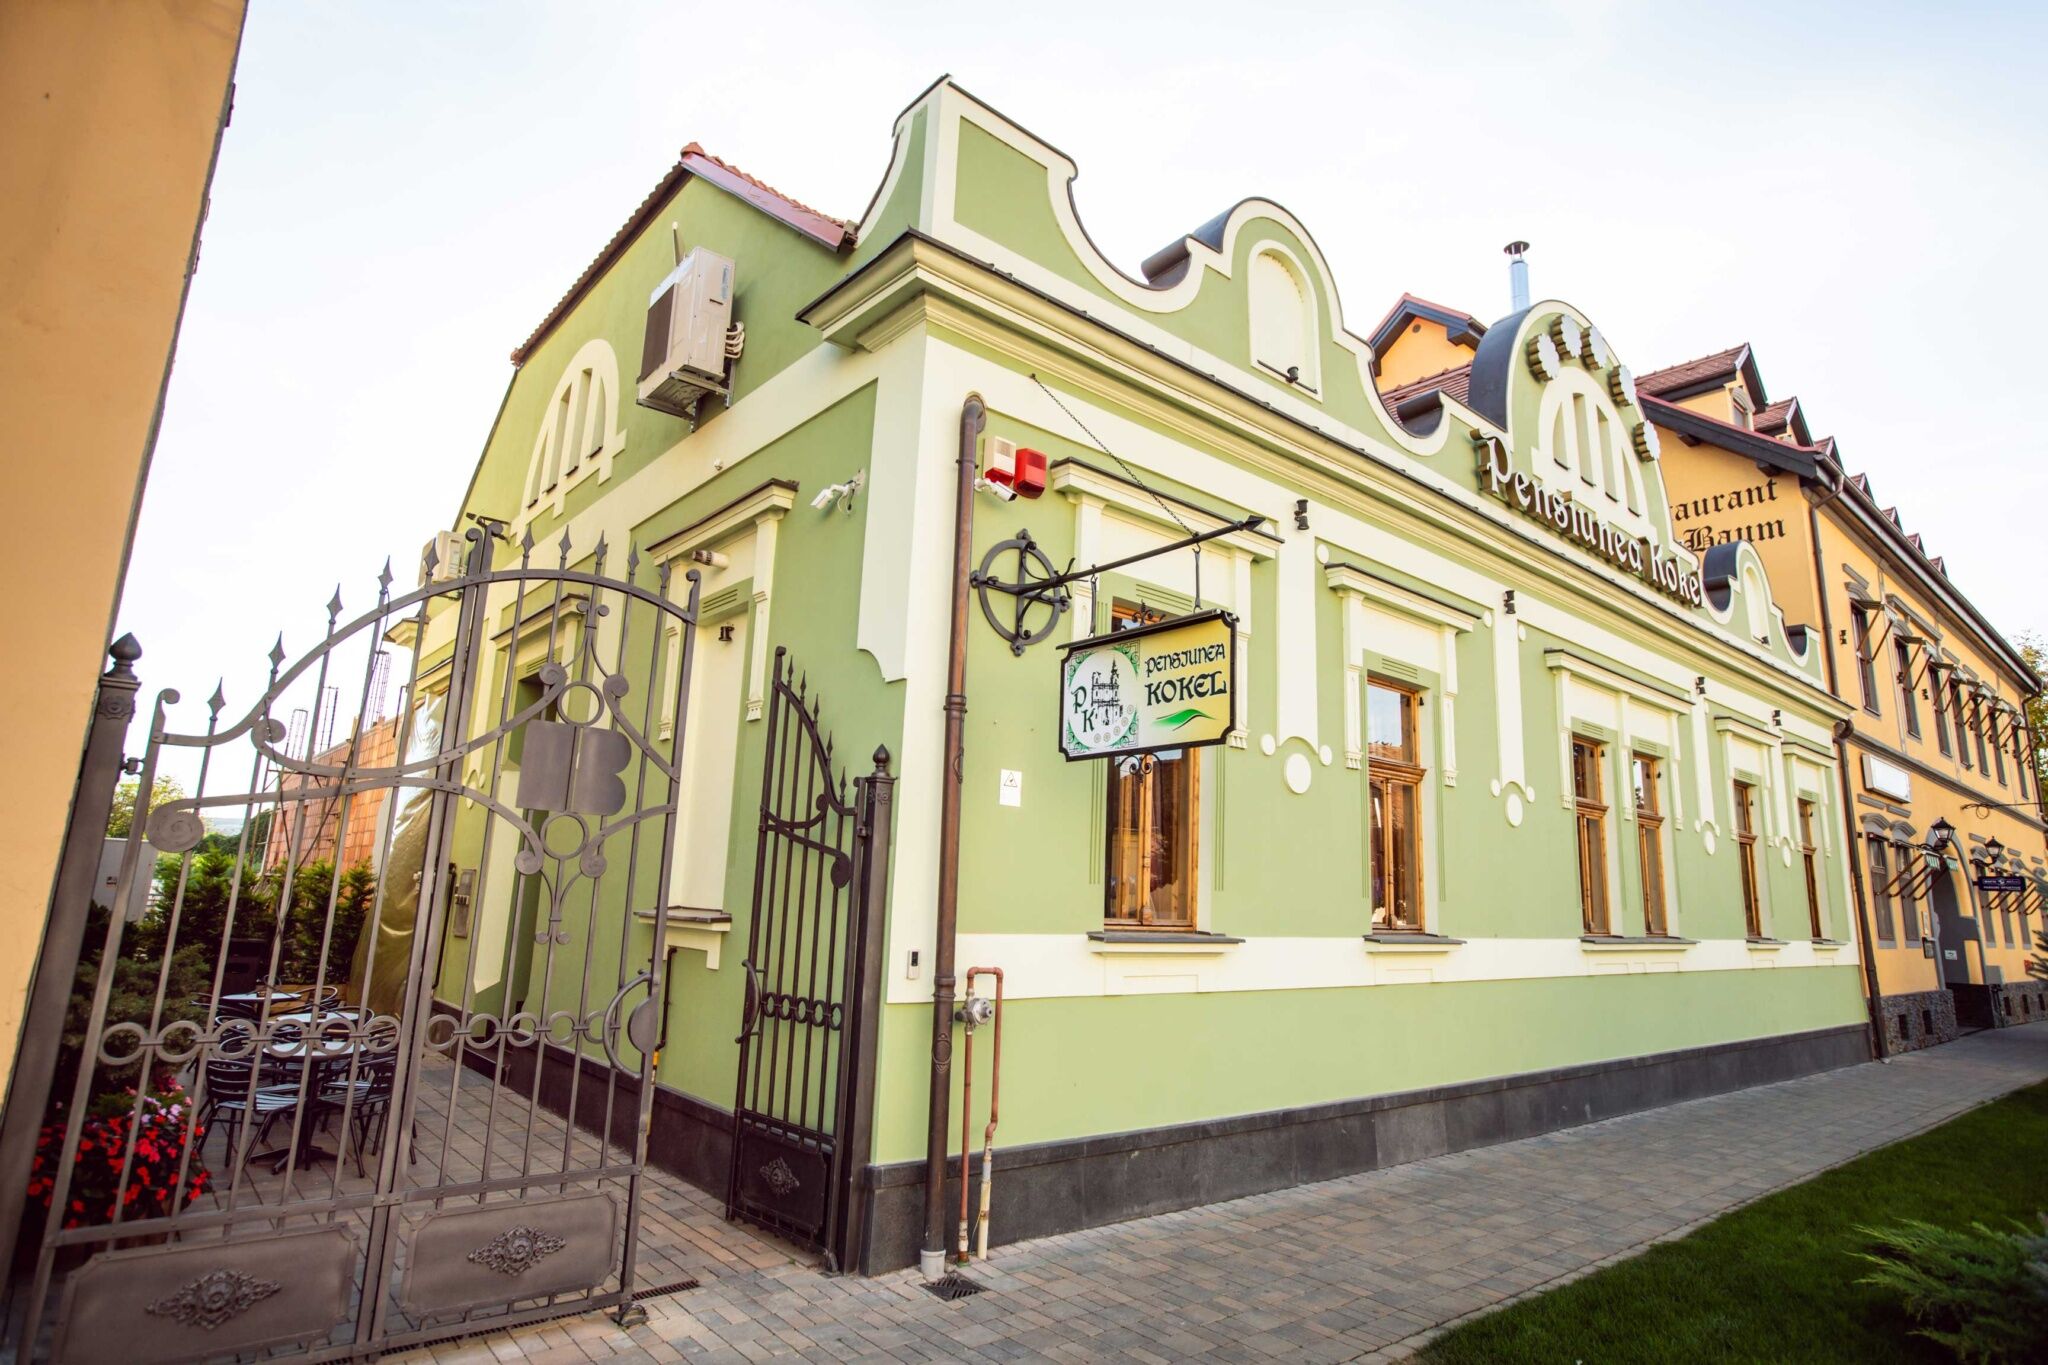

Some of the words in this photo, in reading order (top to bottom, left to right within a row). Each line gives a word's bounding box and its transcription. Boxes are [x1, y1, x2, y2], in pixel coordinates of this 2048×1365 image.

[1474, 428, 1643, 571] Pensiunea
[1670, 478, 1777, 521] aurant
[1144, 670, 1227, 706] KOKEL
[1081, 707, 1095, 733] K
